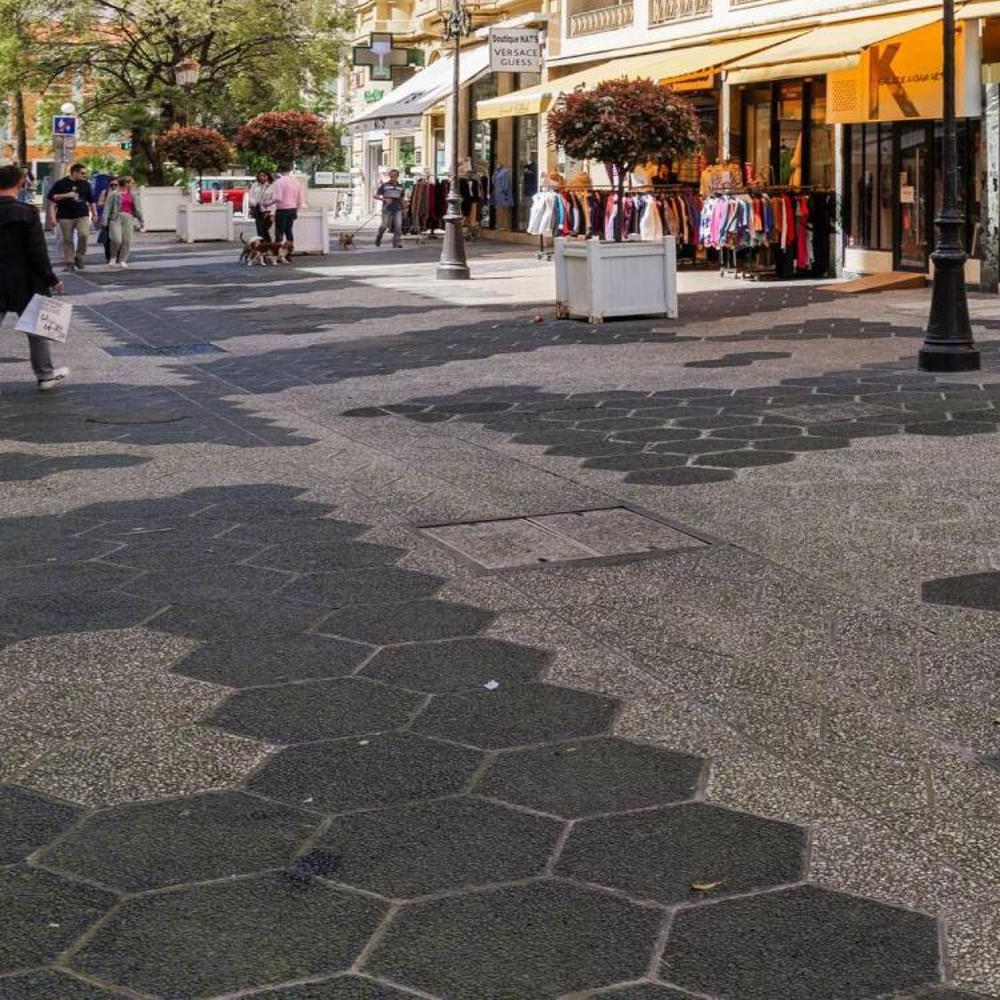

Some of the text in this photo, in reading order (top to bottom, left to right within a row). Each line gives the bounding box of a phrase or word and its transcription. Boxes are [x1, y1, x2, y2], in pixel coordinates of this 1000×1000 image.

[494, 48, 538, 57] VERSACE
[500, 58, 533, 67] GUESS
[868, 42, 921, 121] K
